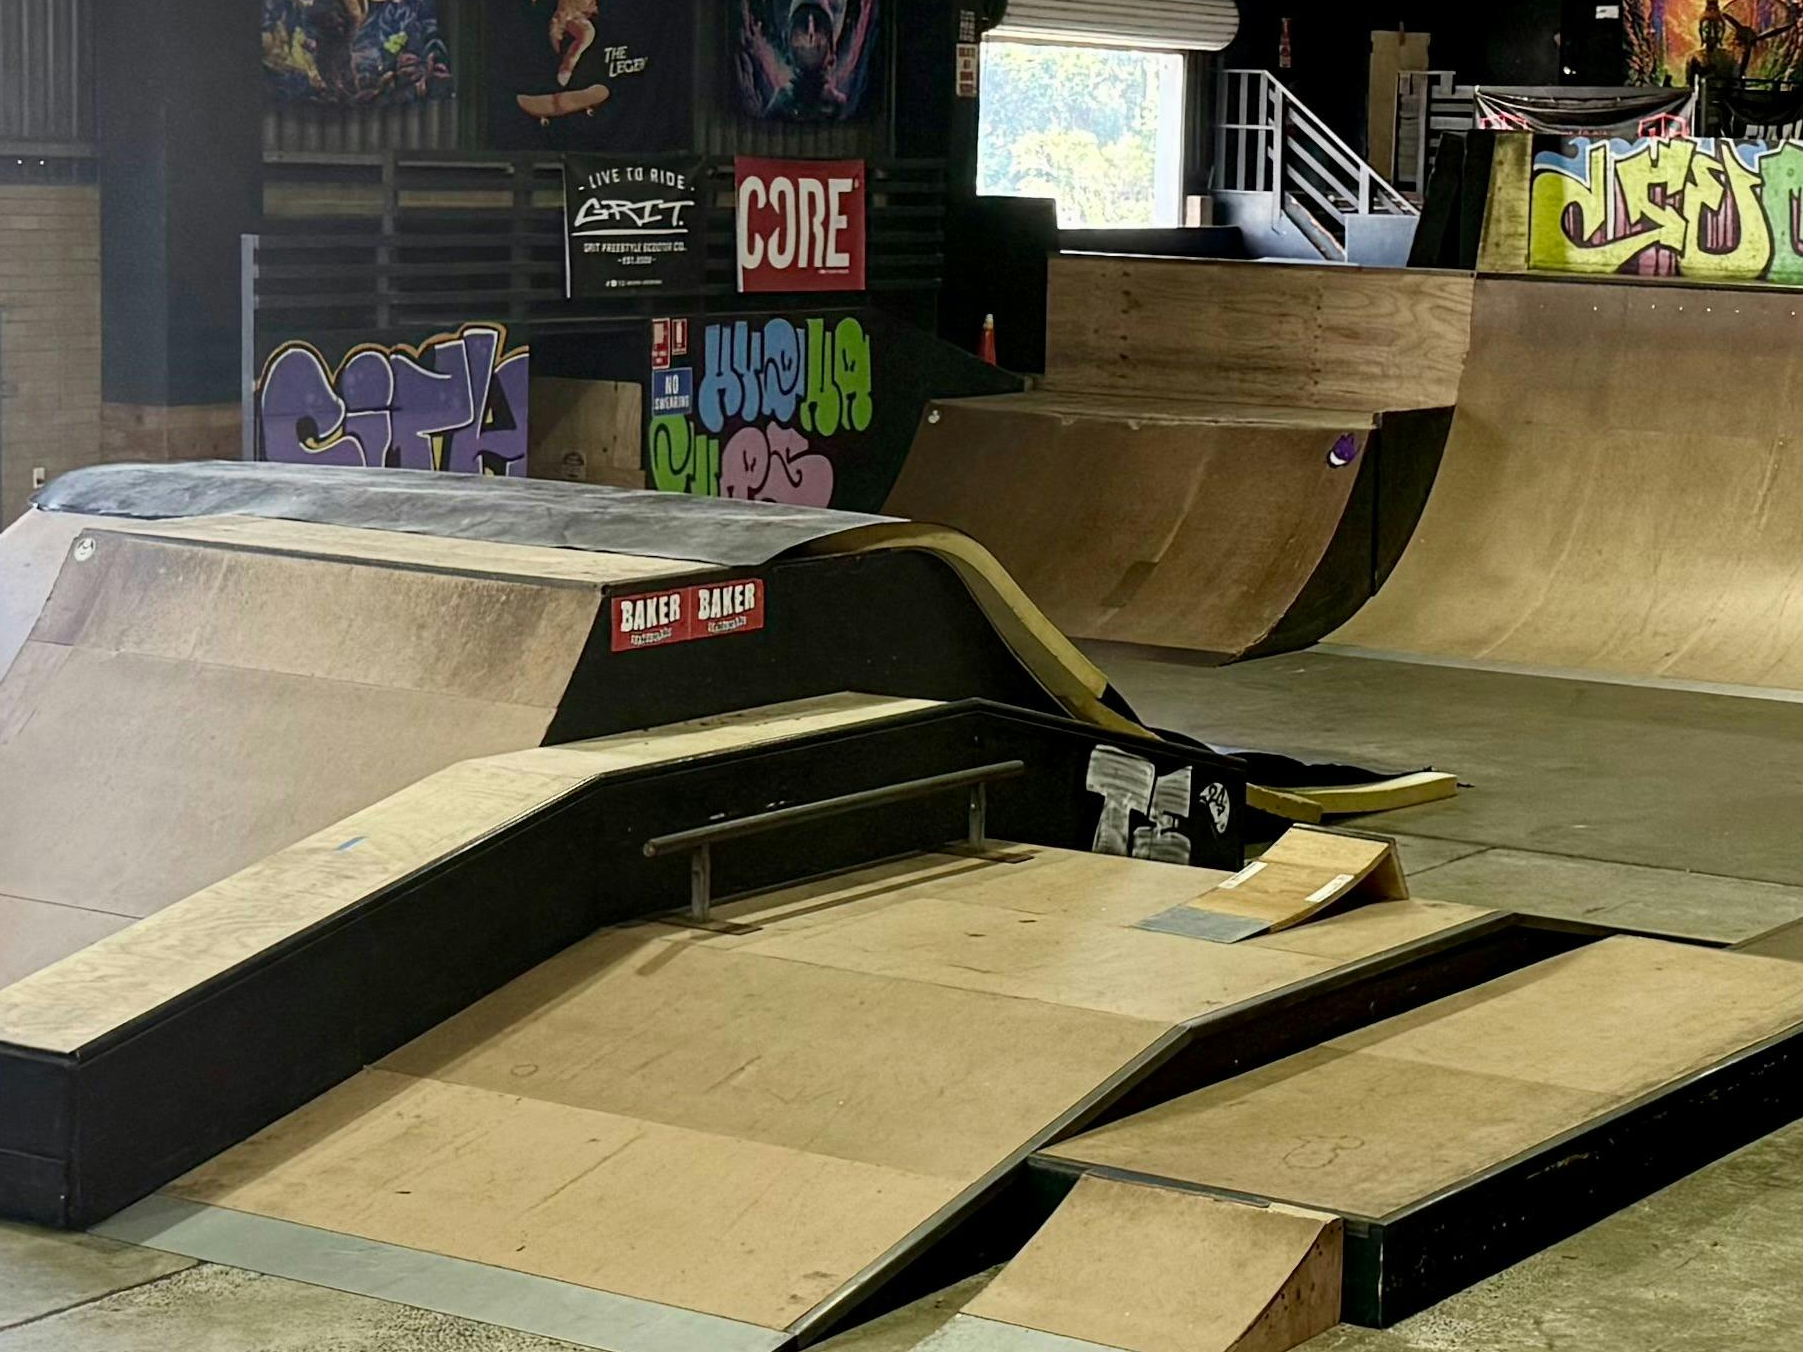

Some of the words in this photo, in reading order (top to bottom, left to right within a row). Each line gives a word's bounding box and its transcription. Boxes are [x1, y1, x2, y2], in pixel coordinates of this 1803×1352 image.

[604, 46, 628, 63] THE
[589, 169, 620, 188] LIVE
[626, 167, 643, 181] TO
[650, 168, 685, 189] RIDE
[739, 176, 853, 269] CORE
[664, 374, 679, 395] NO
[654, 395, 690, 411] SWEARING
[620, 593, 681, 632] BAKER
[698, 582, 756, 621] BAKER
